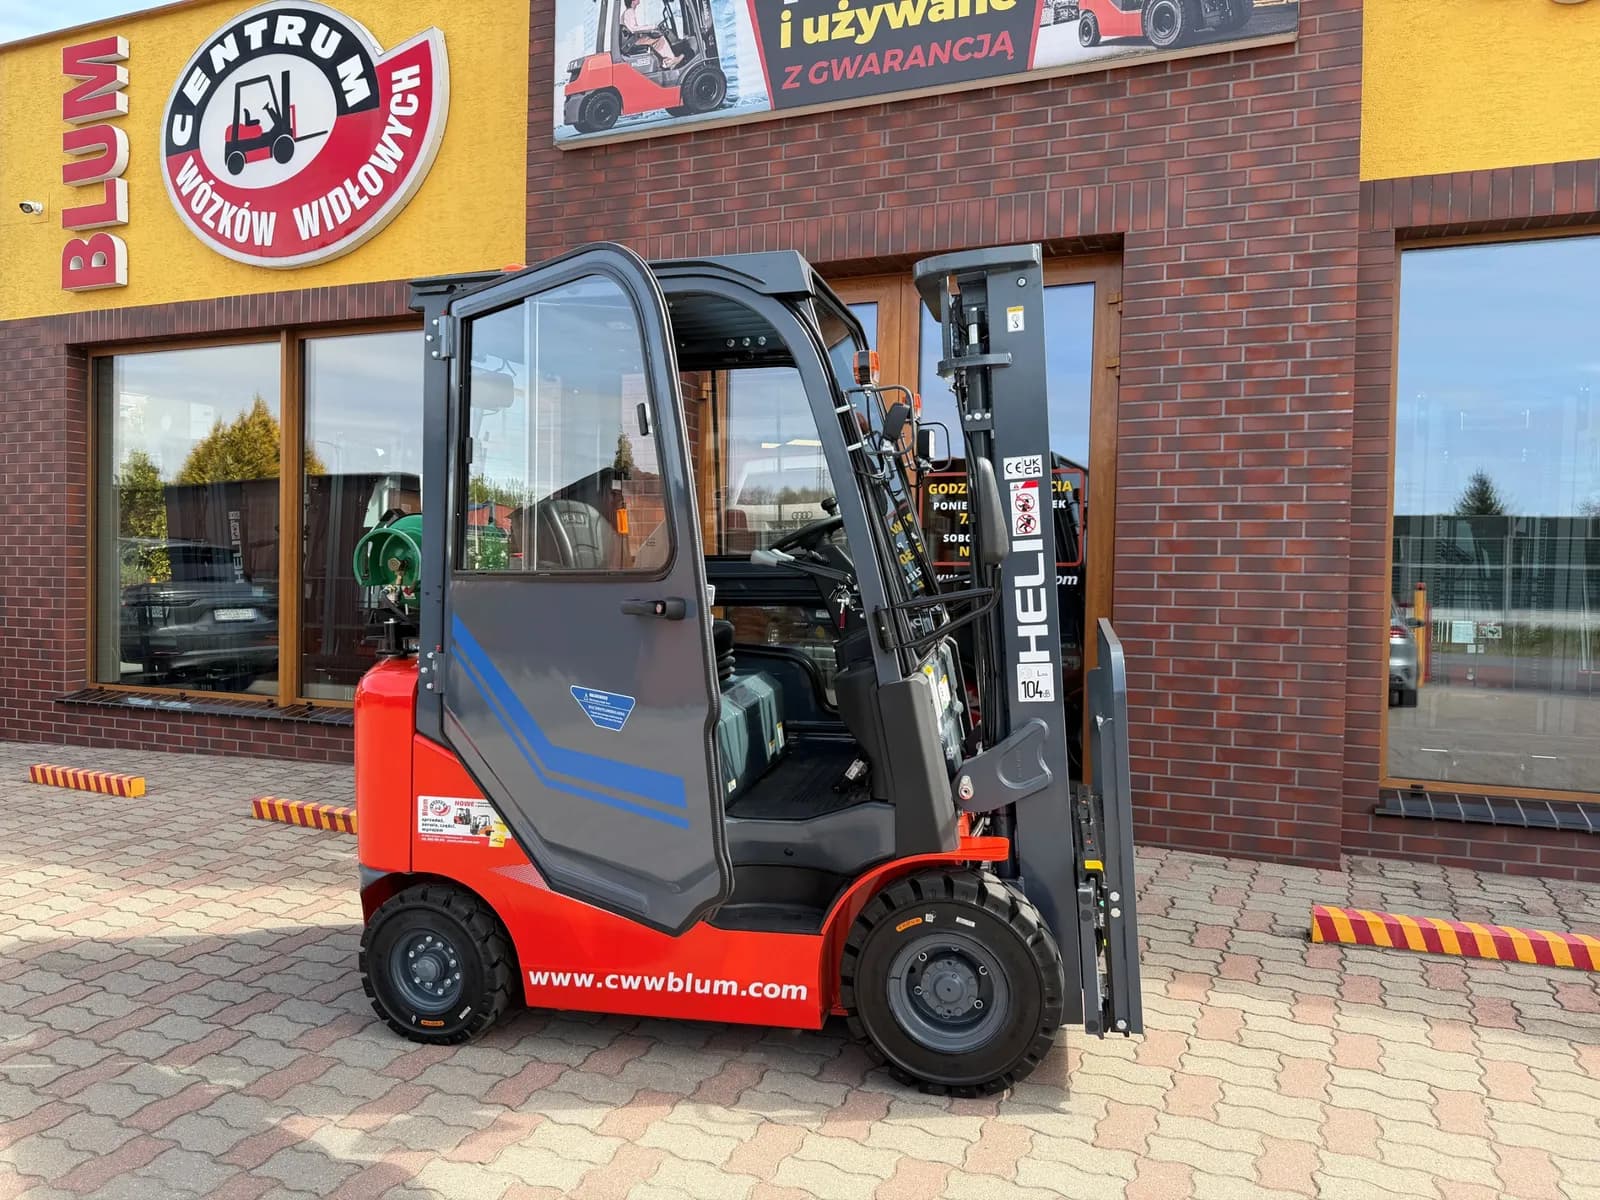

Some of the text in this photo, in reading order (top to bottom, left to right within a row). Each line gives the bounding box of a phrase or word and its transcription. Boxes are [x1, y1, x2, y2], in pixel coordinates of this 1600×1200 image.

[780, 9, 792, 49] i
[171, 15, 371, 147] CENTRUM
[807, 30, 1015, 85] GWARANCJĄ
[61, 35, 129, 292] BLUM
[175, 64, 421, 247] WÓZKÓW WIDŁOWYCH
[1024, 457, 1040, 466] UK
[928, 483, 969, 494] GODZ
[1012, 538, 1050, 663] HELI
[1020, 680, 1043, 699] 104
[528, 970, 808, 1001] www.cwwblum.com
